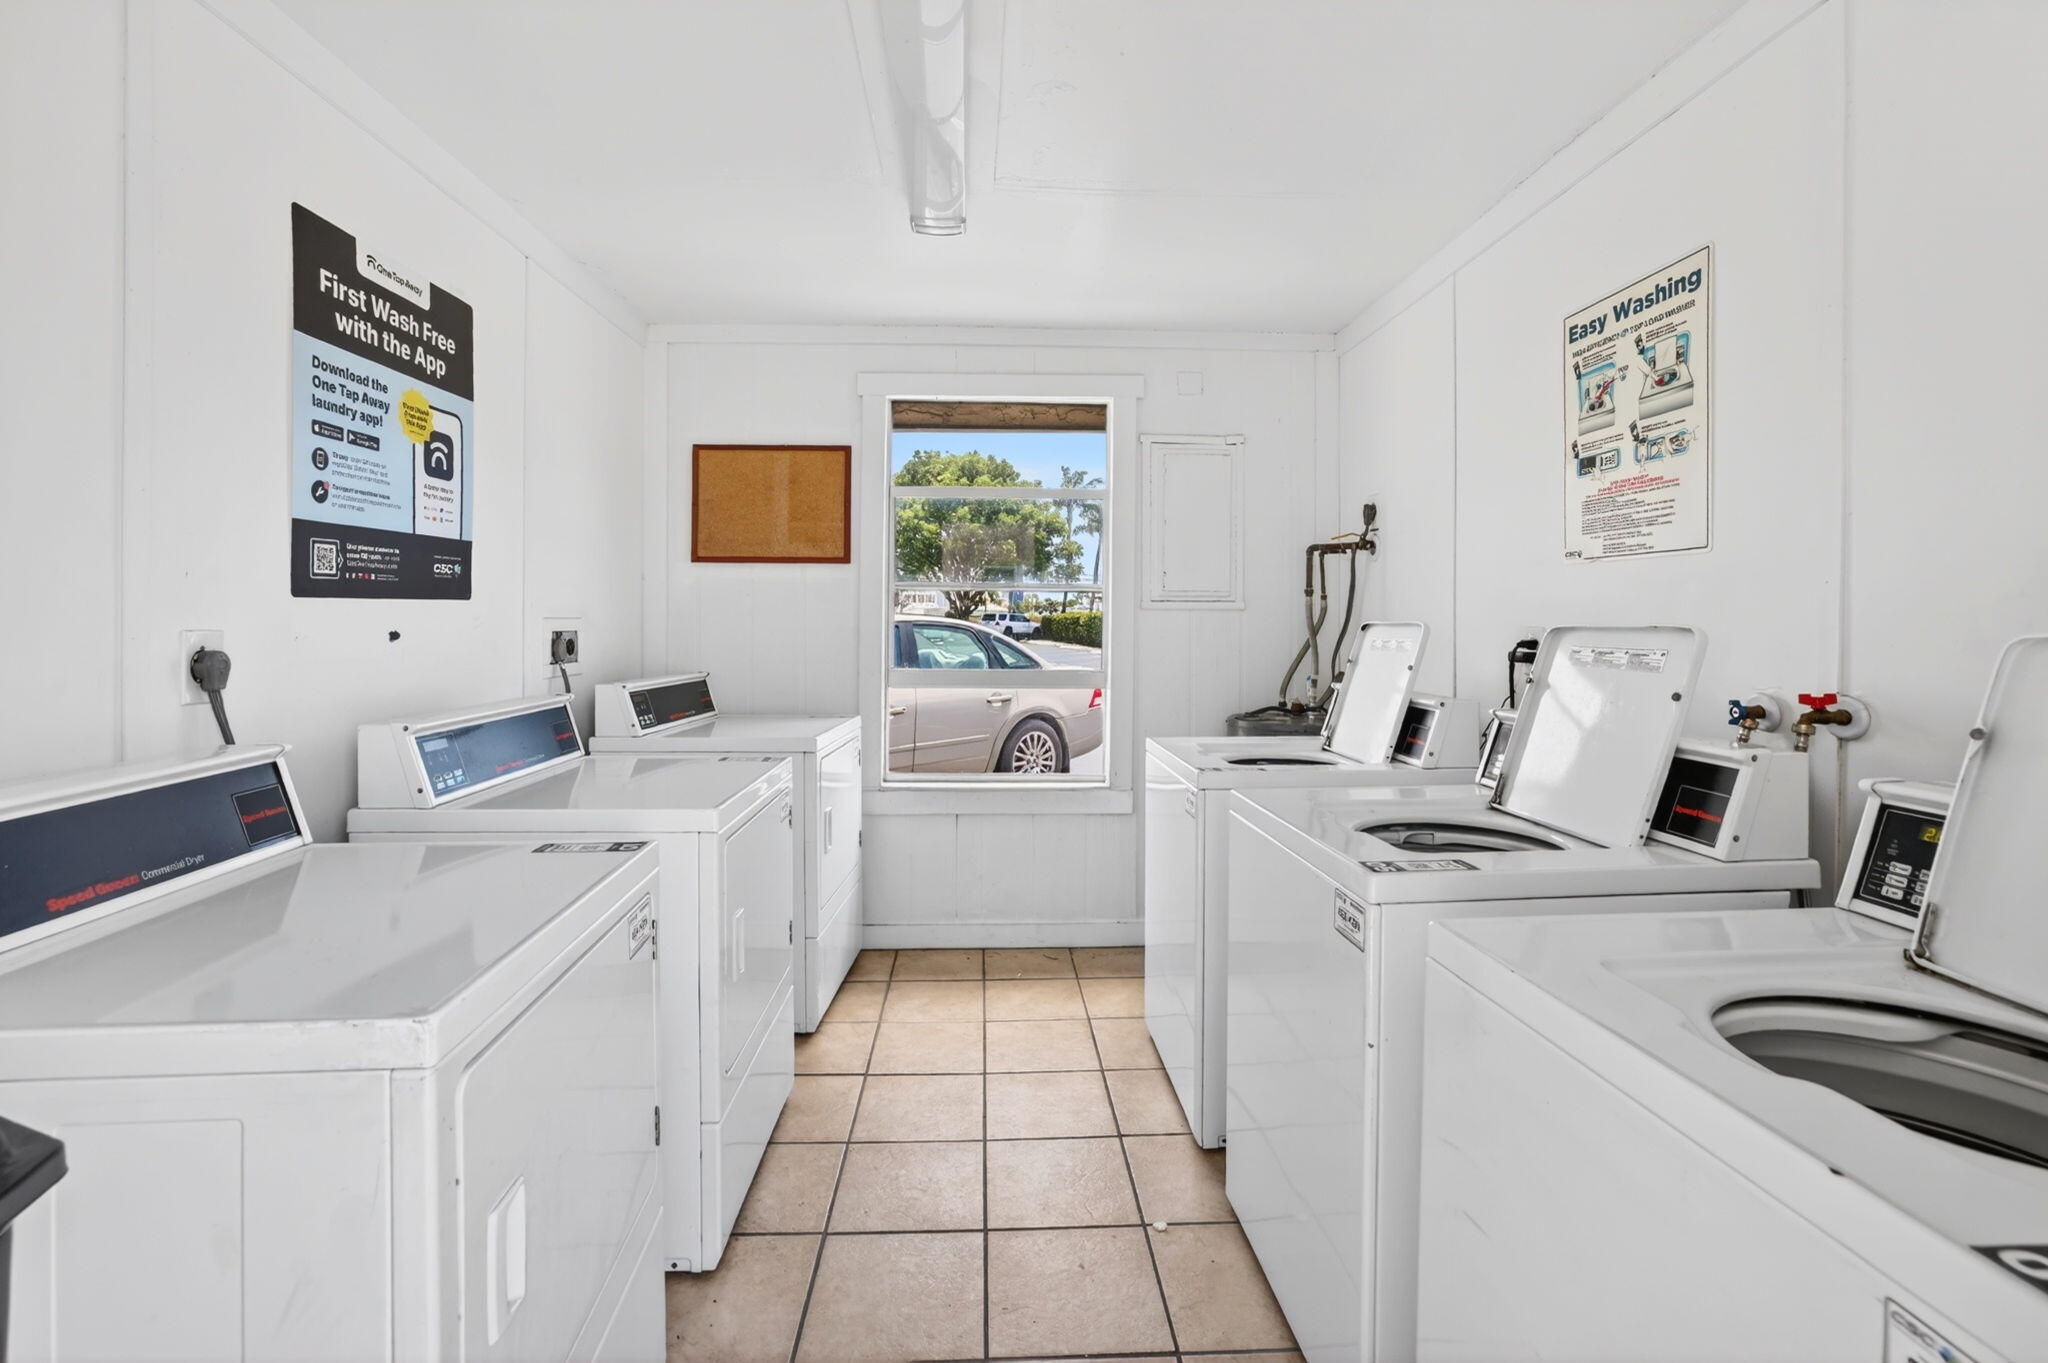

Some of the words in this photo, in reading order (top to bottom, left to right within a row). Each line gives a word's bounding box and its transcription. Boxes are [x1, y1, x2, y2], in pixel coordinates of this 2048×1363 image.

[319, 268, 367, 312] First
[371, 294, 419, 337] Wash
[423, 321, 456, 354] Free
[1568, 313, 1608, 344] Easy
[1612, 268, 1702, 323] Washing
[335, 311, 378, 347] with
[382, 331, 411, 360] the
[414, 346, 447, 378] App
[312, 354, 370, 387] Download
[371, 377, 389, 394] the
[312, 375, 337, 393] One
[338, 383, 360, 403] Tap
[361, 392, 390, 414] Away
[312, 394, 358, 421] laundry
[359, 411, 383, 428] app!
[141, 859, 186, 881] Commercial
[186, 853, 205, 868] Dryer
